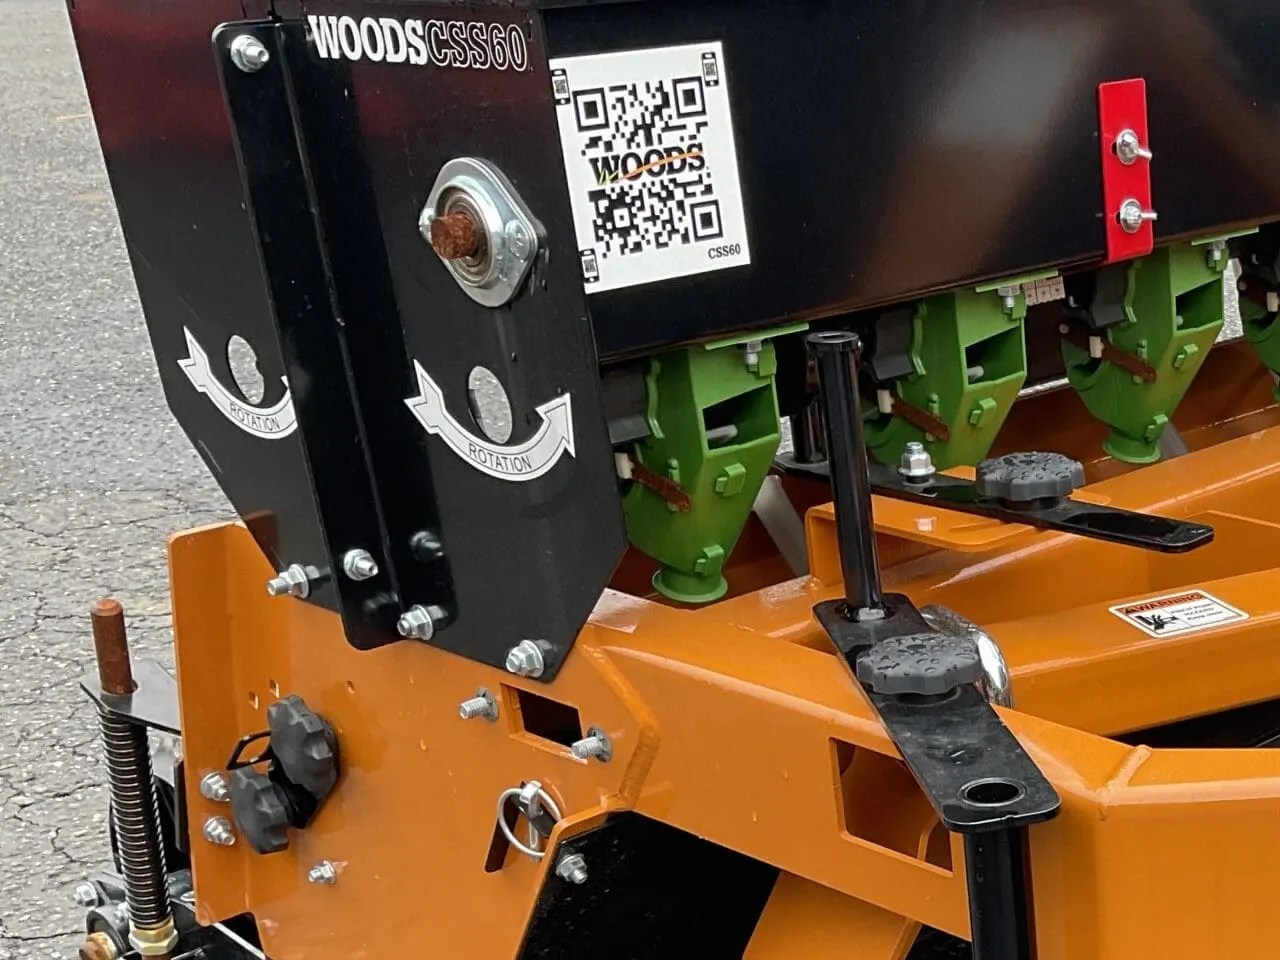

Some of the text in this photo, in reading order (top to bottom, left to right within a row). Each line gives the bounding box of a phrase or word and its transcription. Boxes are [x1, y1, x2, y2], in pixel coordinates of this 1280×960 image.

[588, 143, 707, 186] WOODS
[707, 243, 742, 261] CSS60
[229, 402, 281, 431] ROTATION
[468, 442, 533, 473] ROTATION
